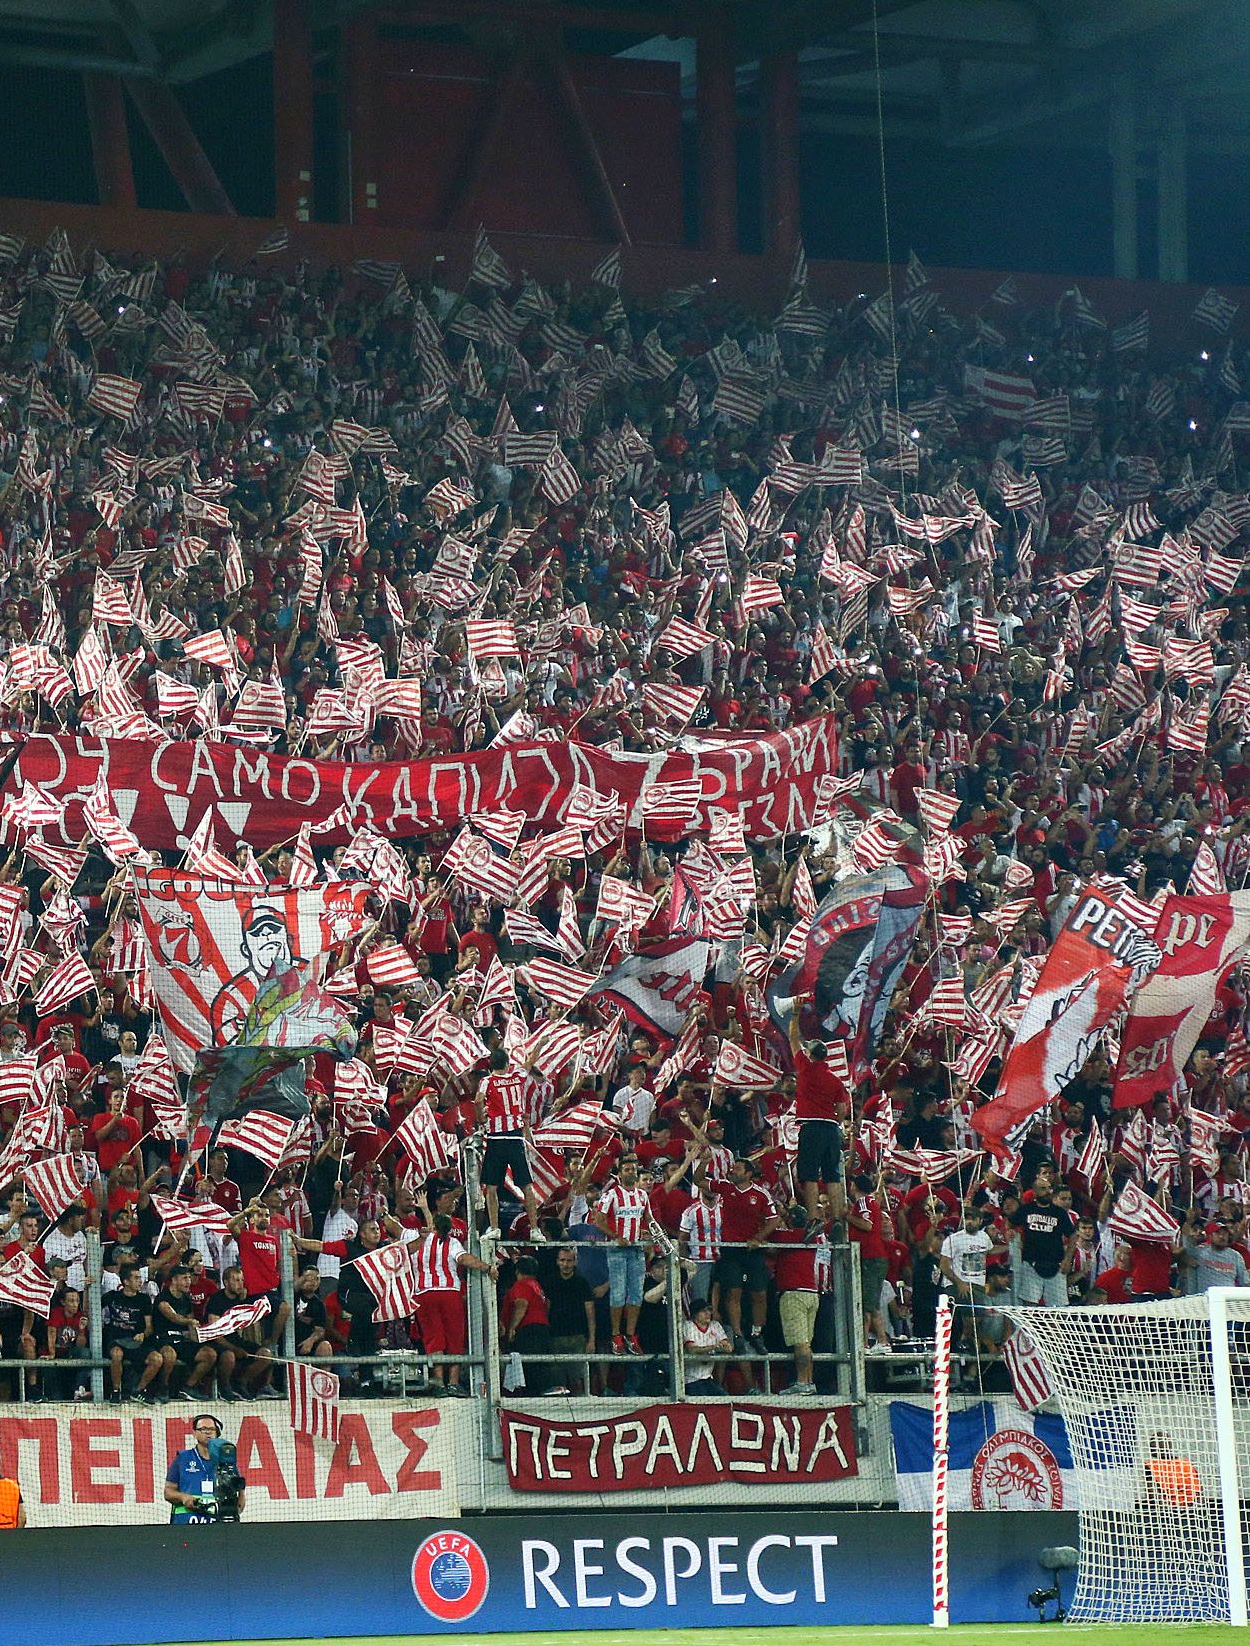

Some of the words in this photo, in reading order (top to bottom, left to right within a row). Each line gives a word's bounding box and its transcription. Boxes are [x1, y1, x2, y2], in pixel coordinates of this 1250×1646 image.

[150, 740, 321, 807] САМО
[497, 1084, 523, 1116] 14
[1029, 1222, 1055, 1233] CLUB
[424, 1536, 472, 1558] UEFA
[521, 1534, 839, 1610] RESPECT
